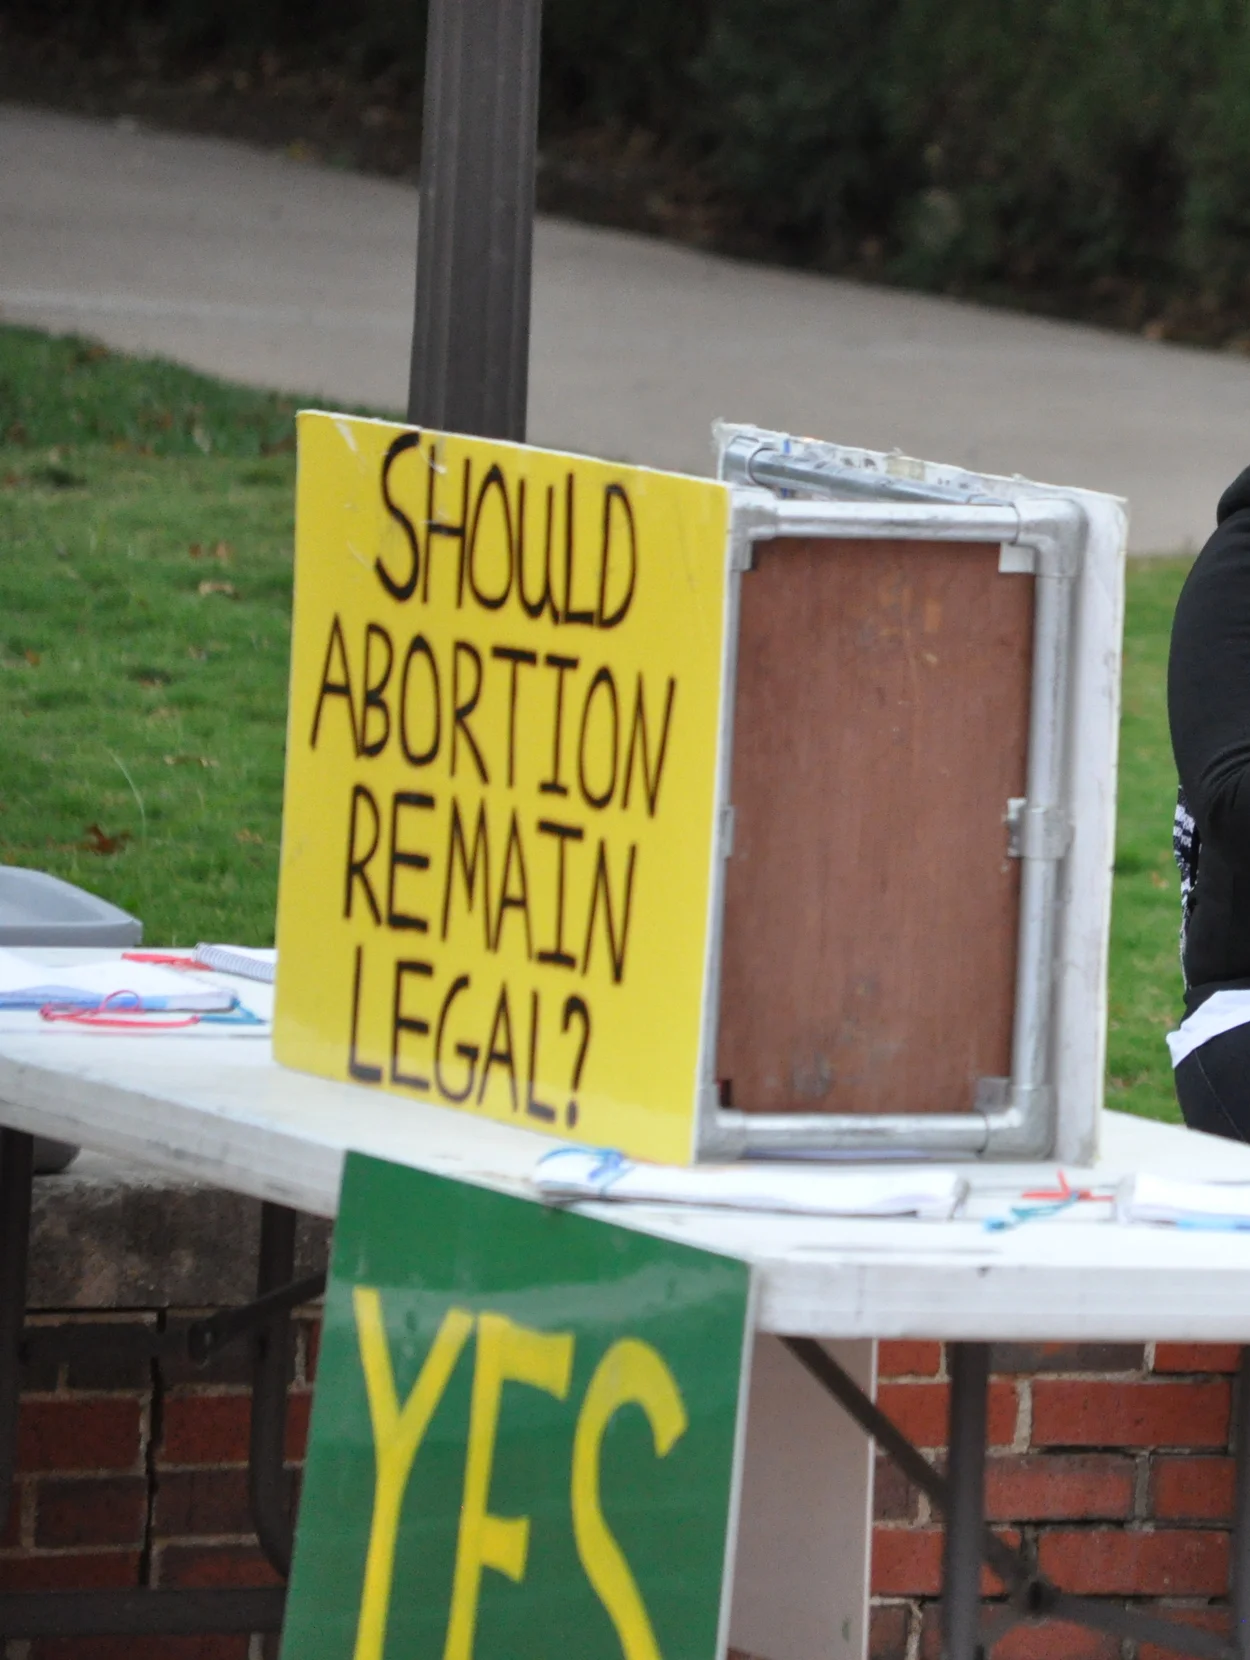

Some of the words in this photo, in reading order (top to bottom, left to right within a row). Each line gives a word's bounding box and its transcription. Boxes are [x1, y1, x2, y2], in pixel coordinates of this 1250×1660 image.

[375, 432, 637, 629] SHOULD
[310, 613, 676, 817] ABORTION
[343, 784, 637, 985] REMAIN
[348, 945, 592, 1128] LEGAL?
